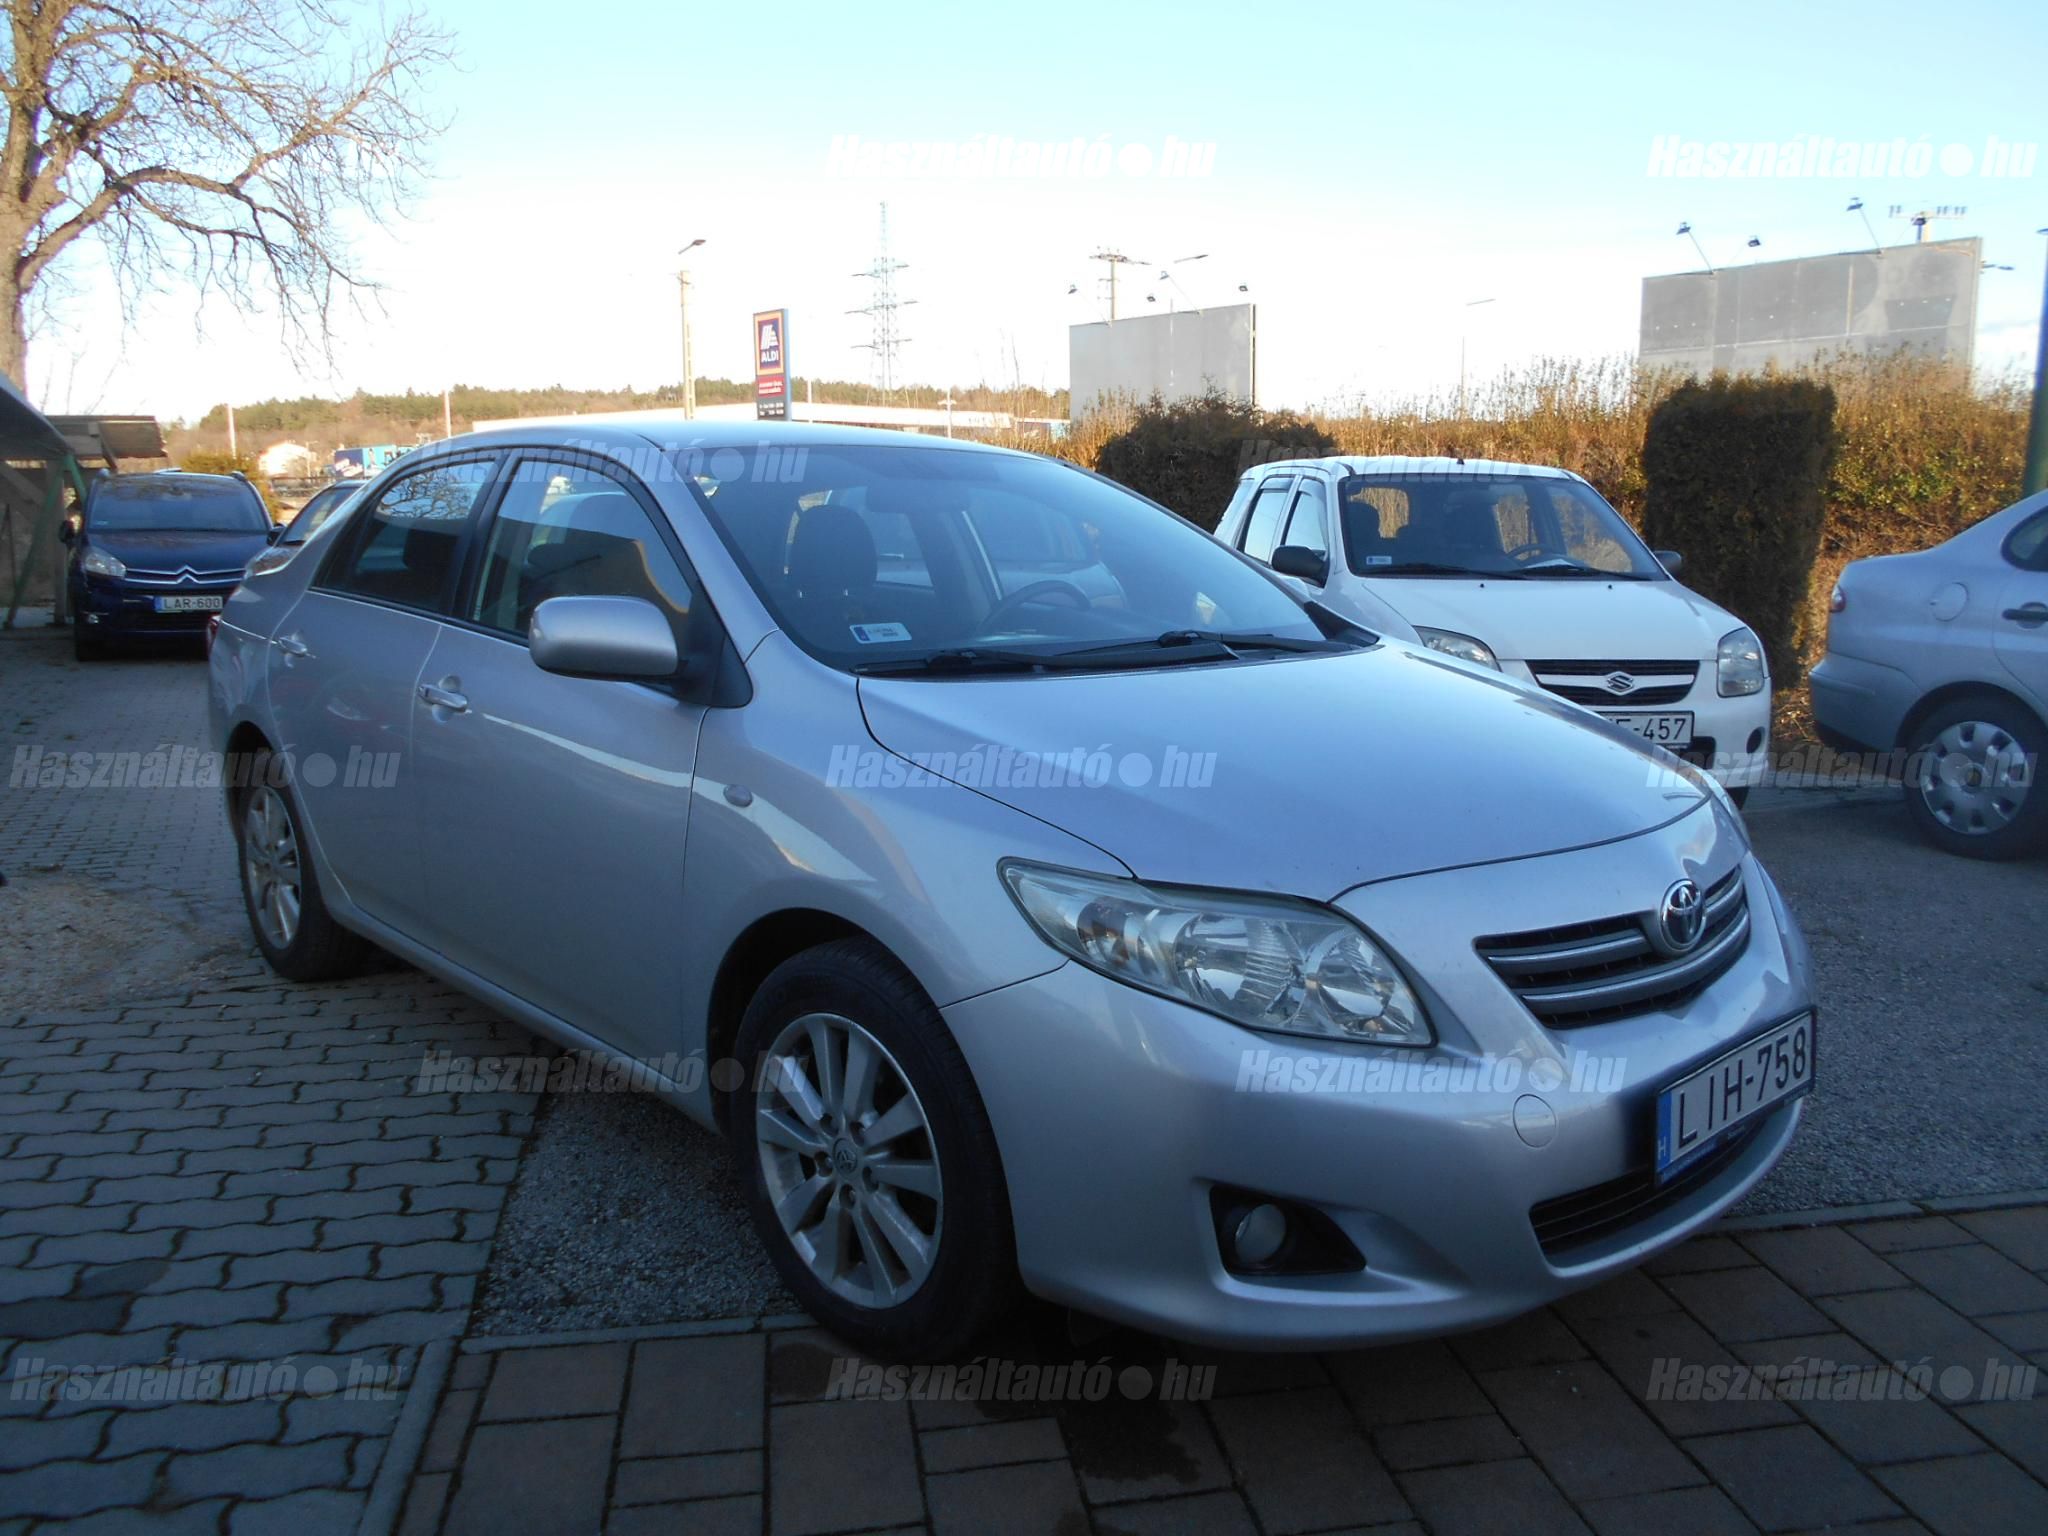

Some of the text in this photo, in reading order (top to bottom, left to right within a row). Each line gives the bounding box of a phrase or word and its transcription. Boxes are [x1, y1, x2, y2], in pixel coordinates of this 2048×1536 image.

[761, 350, 779, 363] ALDI
[164, 598, 220, 609] LAR-600
[1678, 1026, 1806, 1149] LIH-758
